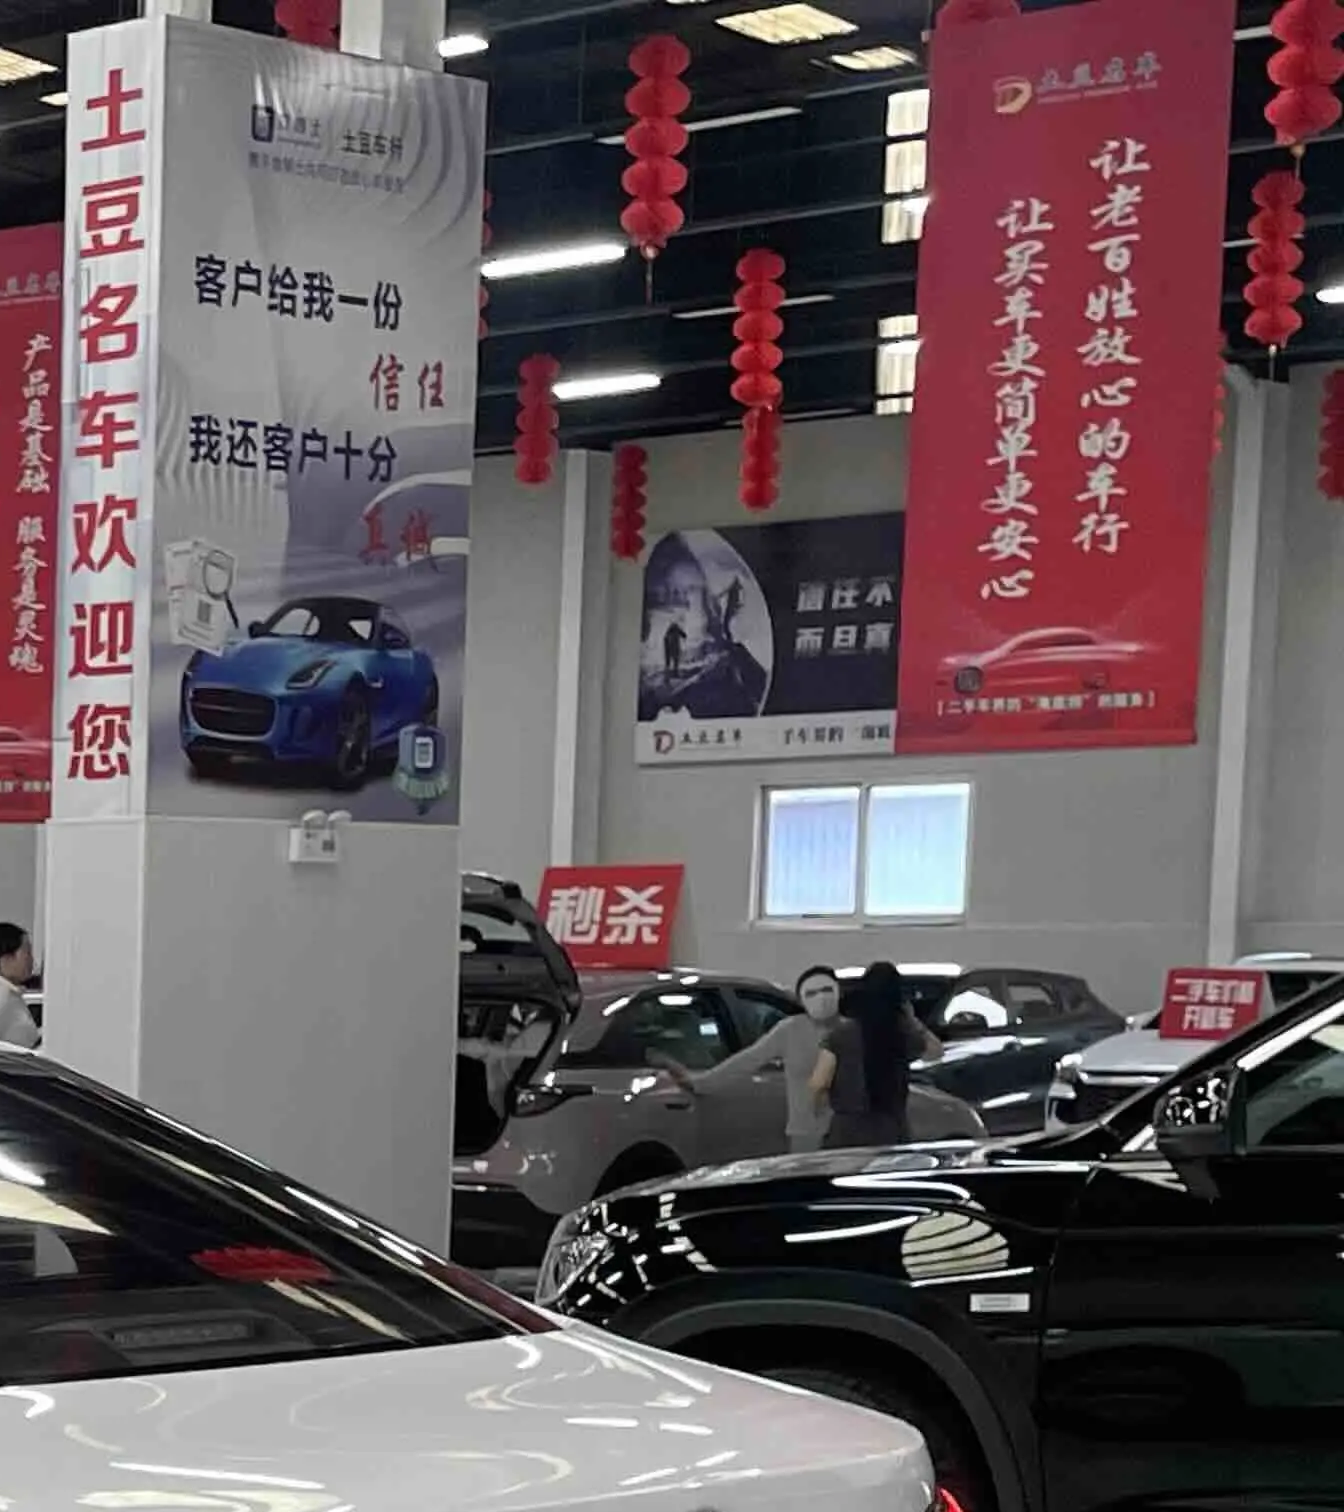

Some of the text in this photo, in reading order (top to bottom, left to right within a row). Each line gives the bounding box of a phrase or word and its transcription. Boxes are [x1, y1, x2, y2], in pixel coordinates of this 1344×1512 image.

[194, 253, 403, 331] 客户给我一份
[1073, 137, 1153, 556] 让老百姓放心的车行
[16, 332, 53, 494] 产品是基础
[67, 68, 147, 780] 土豆名车欢迎您
[189, 415, 398, 482] 我还客户十分
[369, 353, 445, 412] 信任
[978, 196, 1054, 602] 让买车更简单更安心
[9, 516, 47, 674] 服务是灵魂
[547, 881, 665, 946] 秒杀
